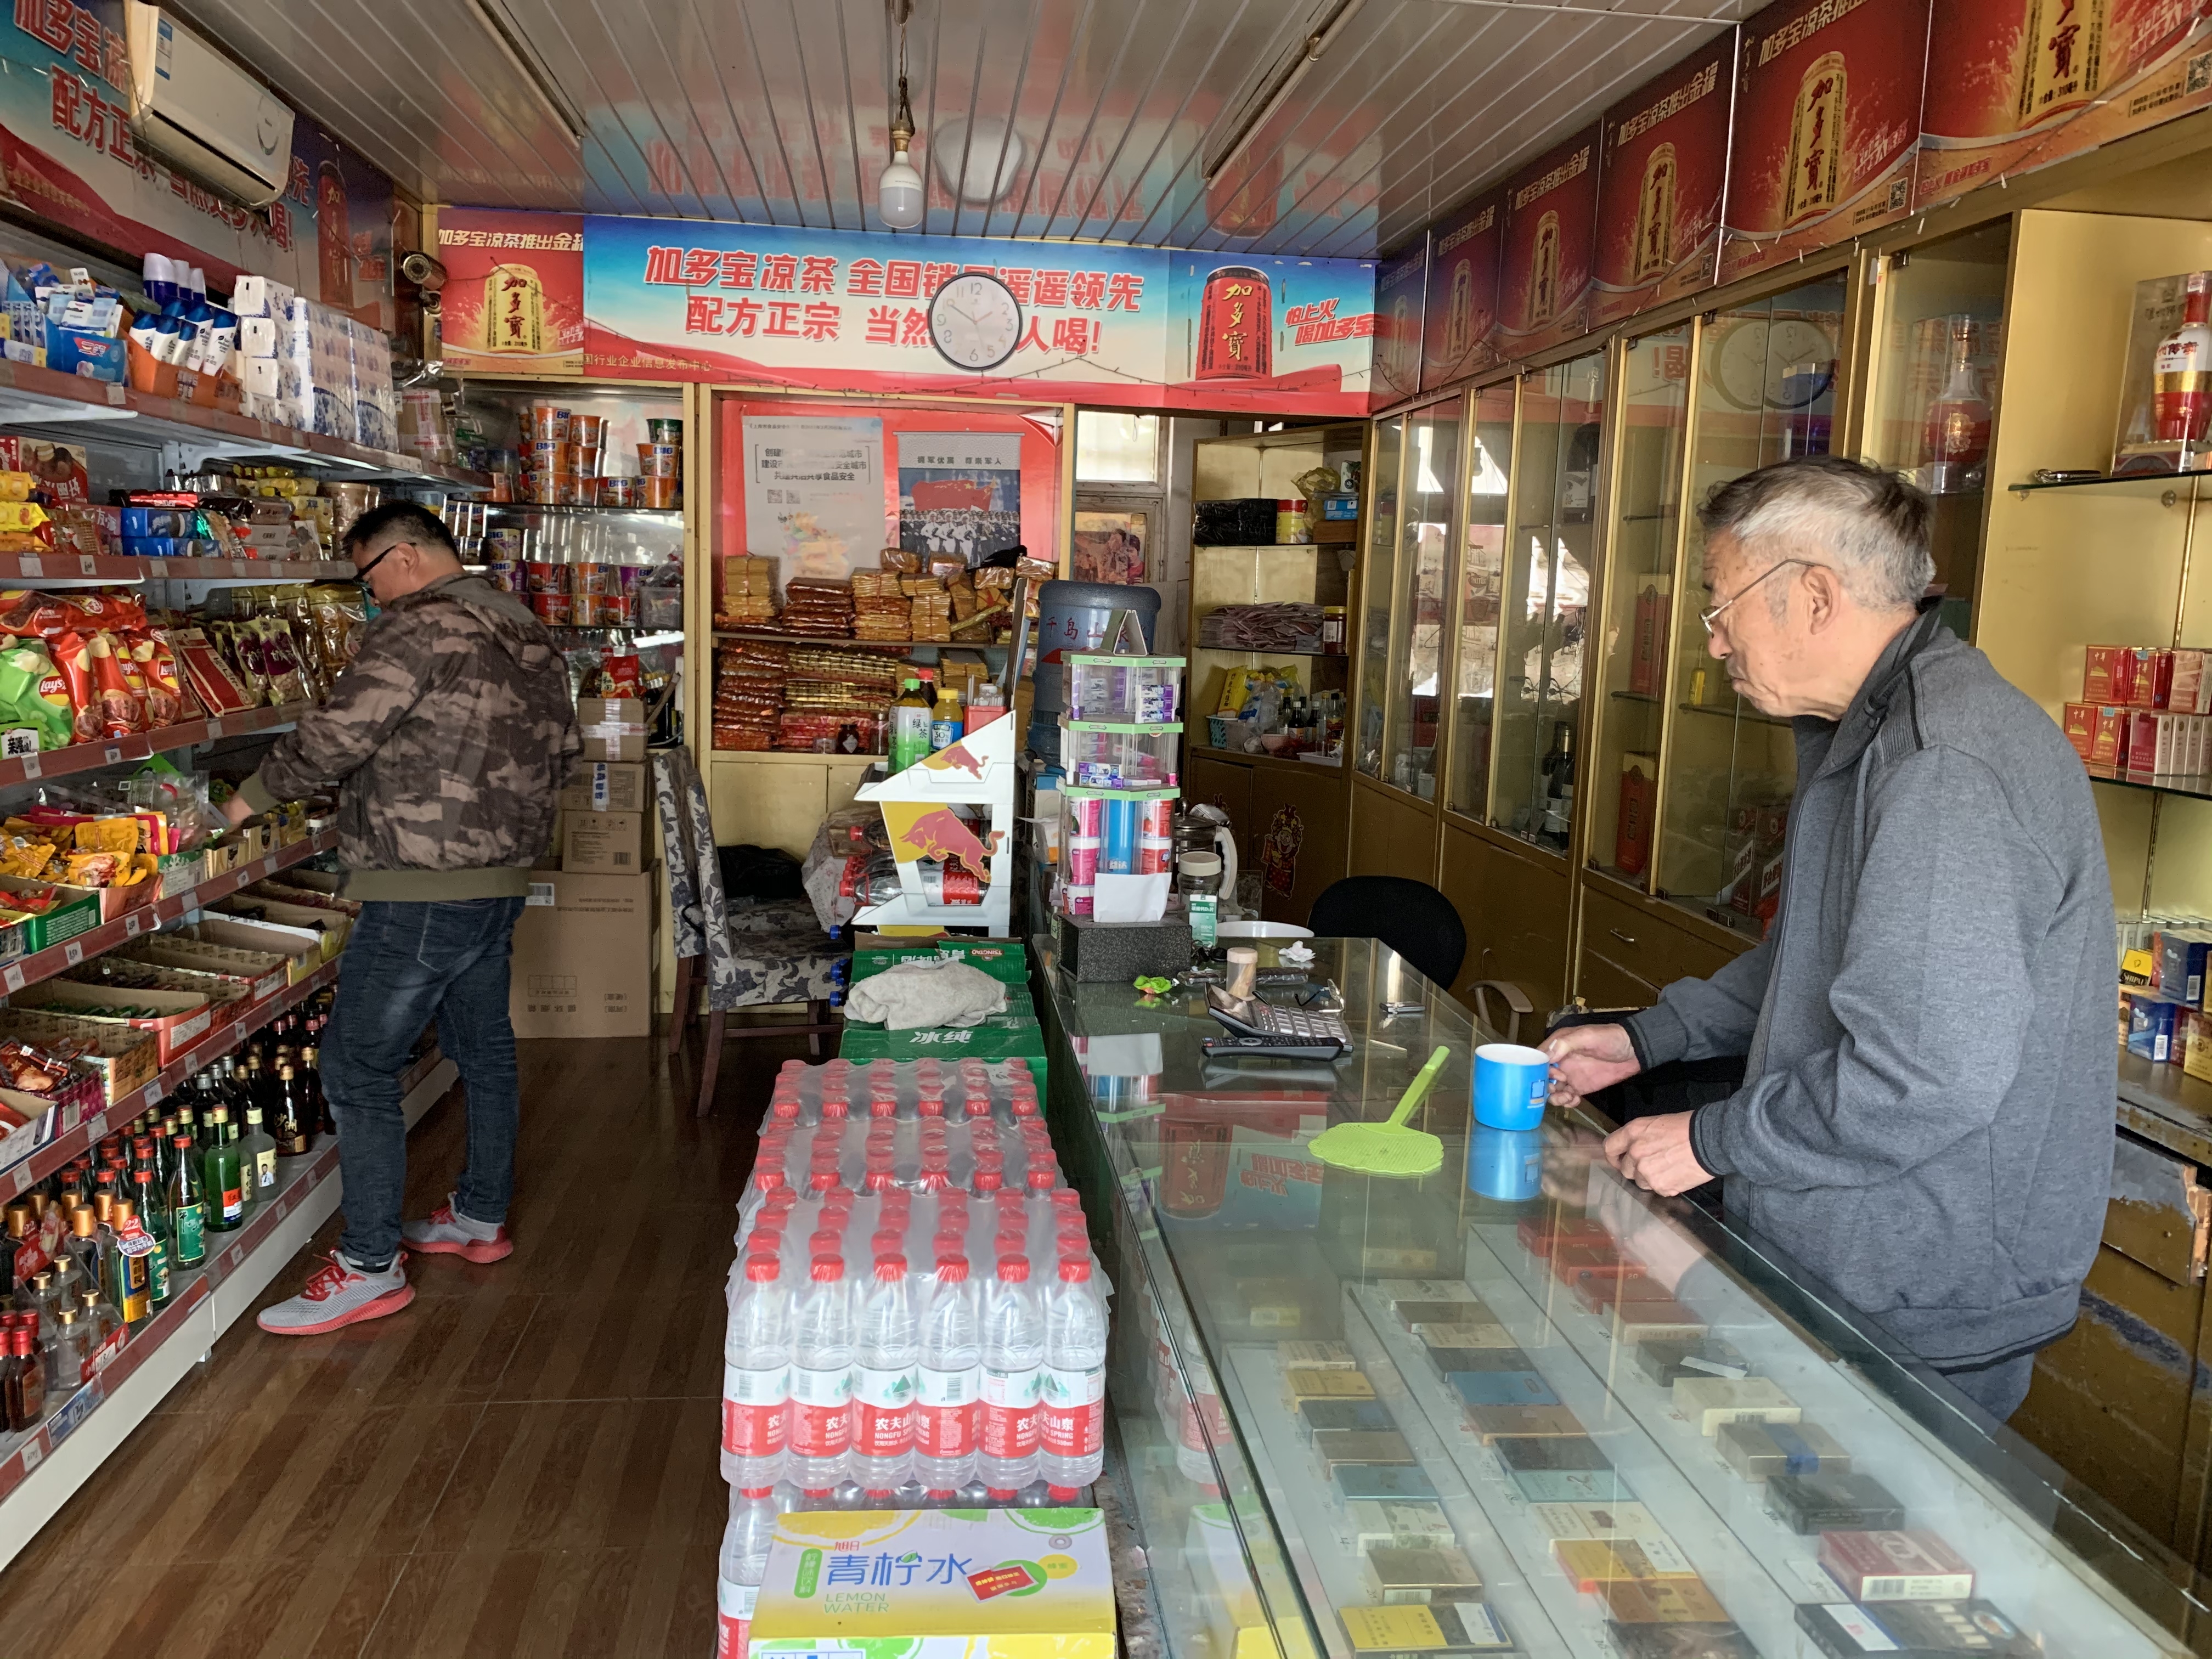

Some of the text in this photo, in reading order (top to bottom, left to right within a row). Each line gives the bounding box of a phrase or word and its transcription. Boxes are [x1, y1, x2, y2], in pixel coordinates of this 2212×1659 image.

[645, 246, 838, 294] 加多宝凉茶
[971, 283, 983, 295] 12
[685, 294, 843, 341] 配方正宗
[1284, 297, 1340, 327] 怕上火
[1294, 313, 1375, 347] 喝加多宝
[653, 447, 673, 455] BIG
[608, 479, 628, 487] BIG
[40, 678, 64, 693] Lay's
[909, 1030, 974, 1045] 冰纯
[874, 1431, 901, 1440] NONGFU
[1050, 1428, 1074, 1440] SPRING
[834, 1541, 860, 1552] 旭日
[827, 1551, 973, 1586] 青柠水
[826, 1592, 885, 1603] LEMON
[824, 1602, 890, 1614] WATER
